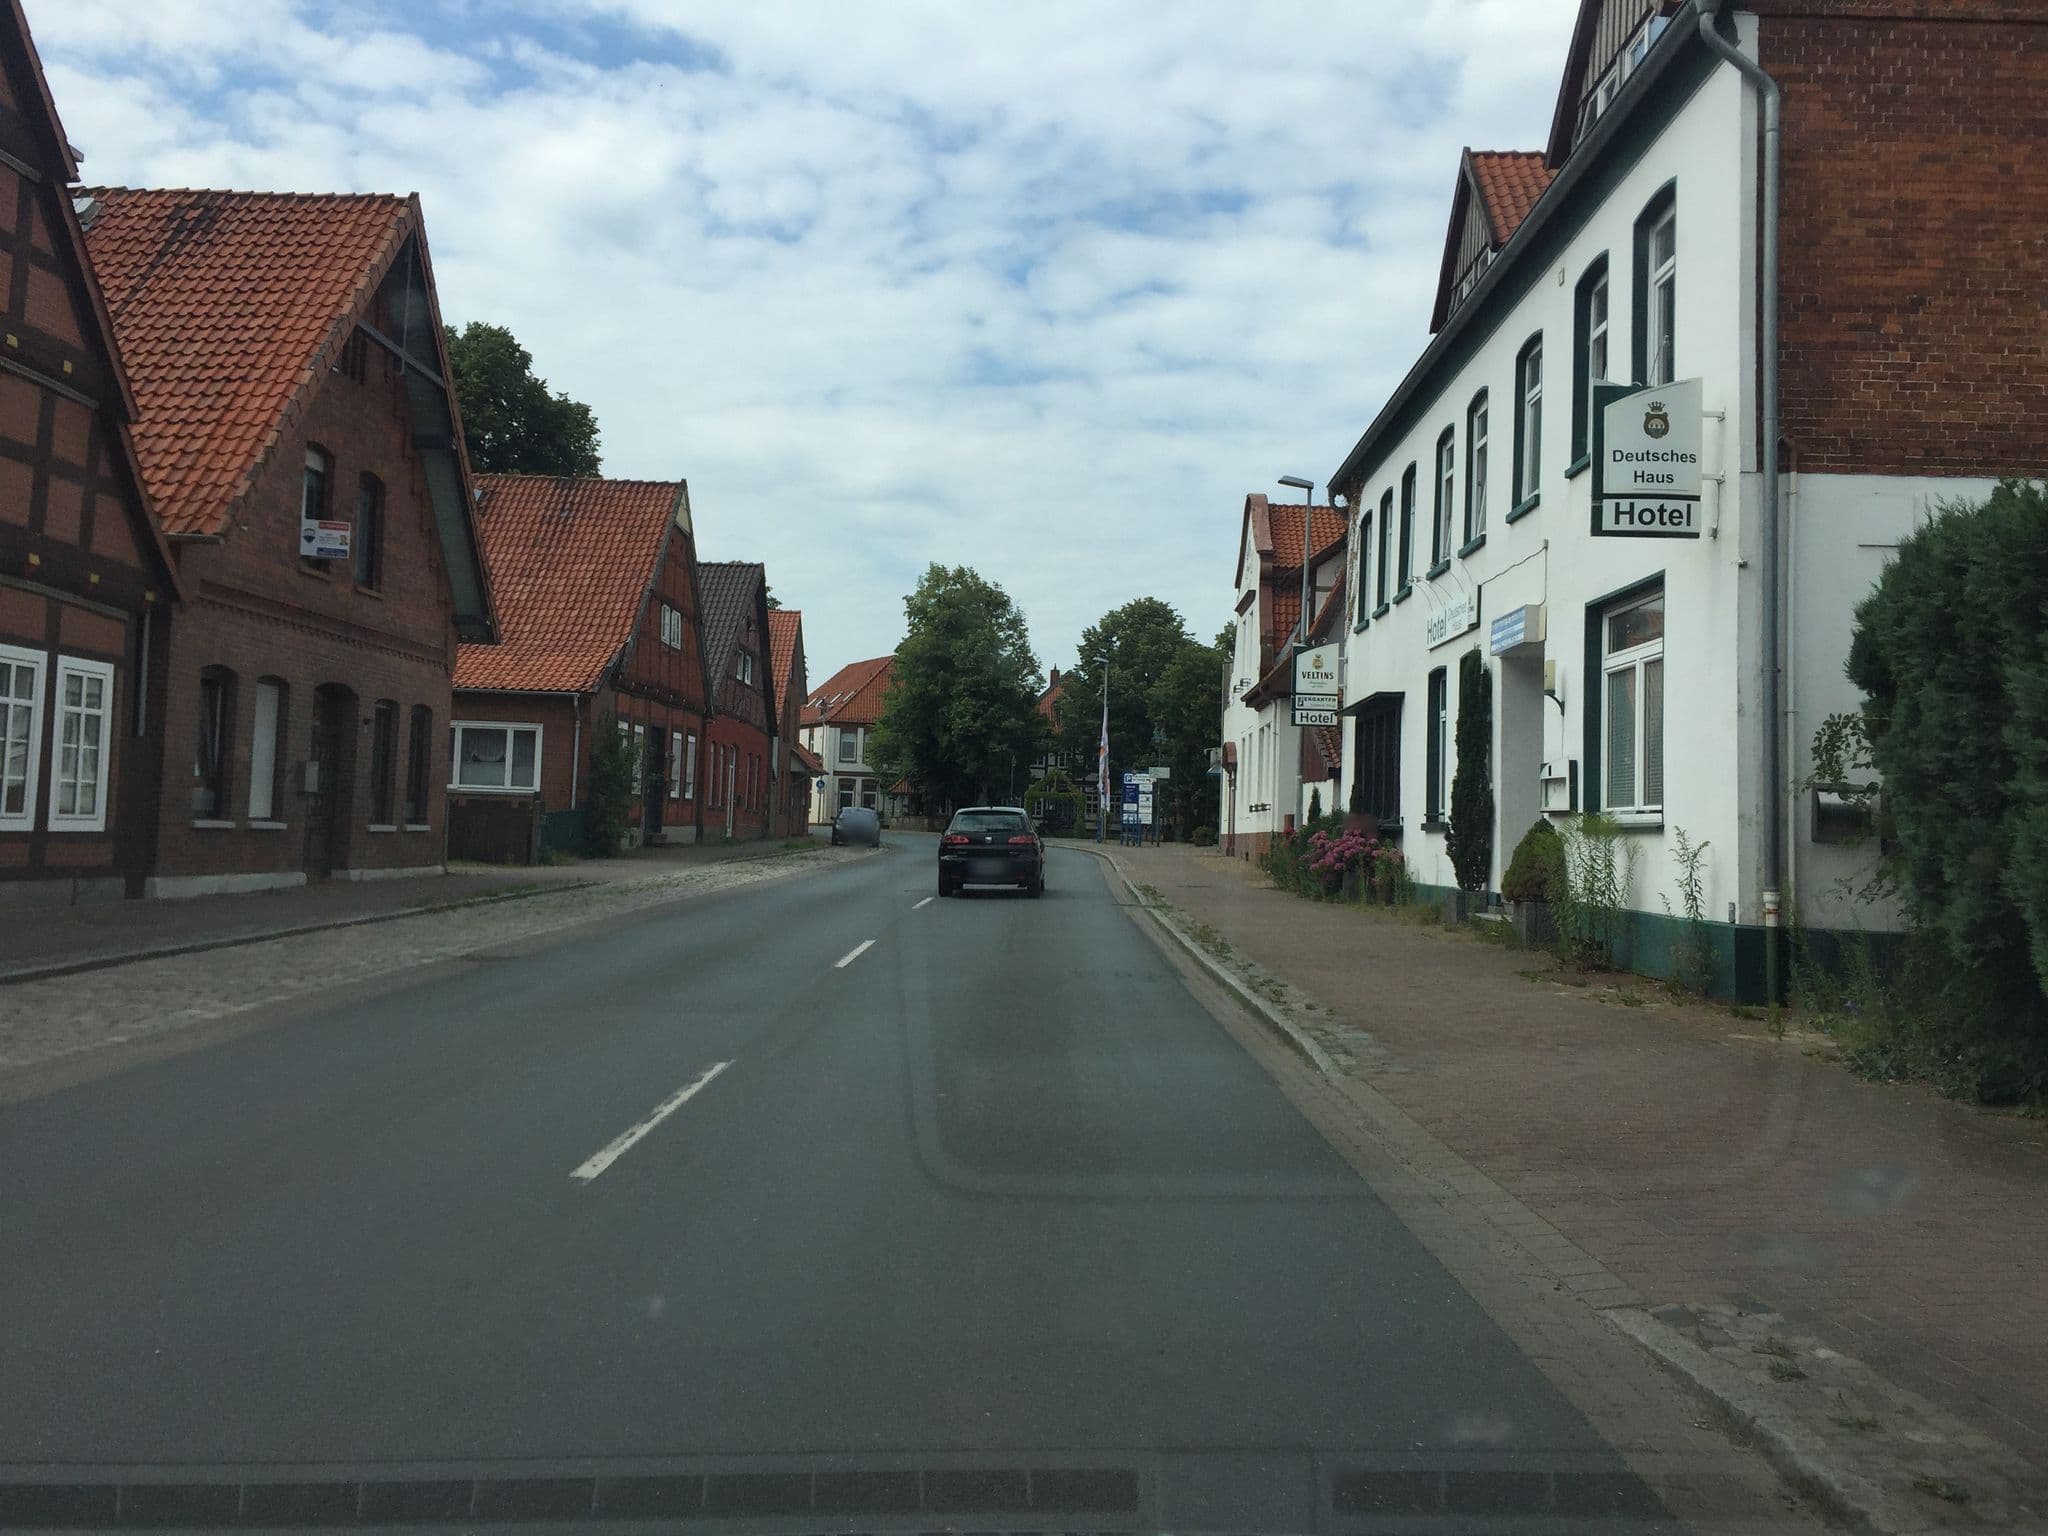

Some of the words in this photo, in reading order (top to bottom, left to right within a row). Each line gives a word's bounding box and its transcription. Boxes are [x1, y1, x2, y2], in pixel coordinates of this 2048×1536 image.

[1612, 449, 1697, 464] Deutsches
[1633, 470, 1674, 484] Haus
[1614, 502, 1691, 527] Hotel
[1426, 609, 1447, 645] Hotel
[1301, 671, 1334, 680] VELTINS
[1300, 711, 1333, 724] Hotel
